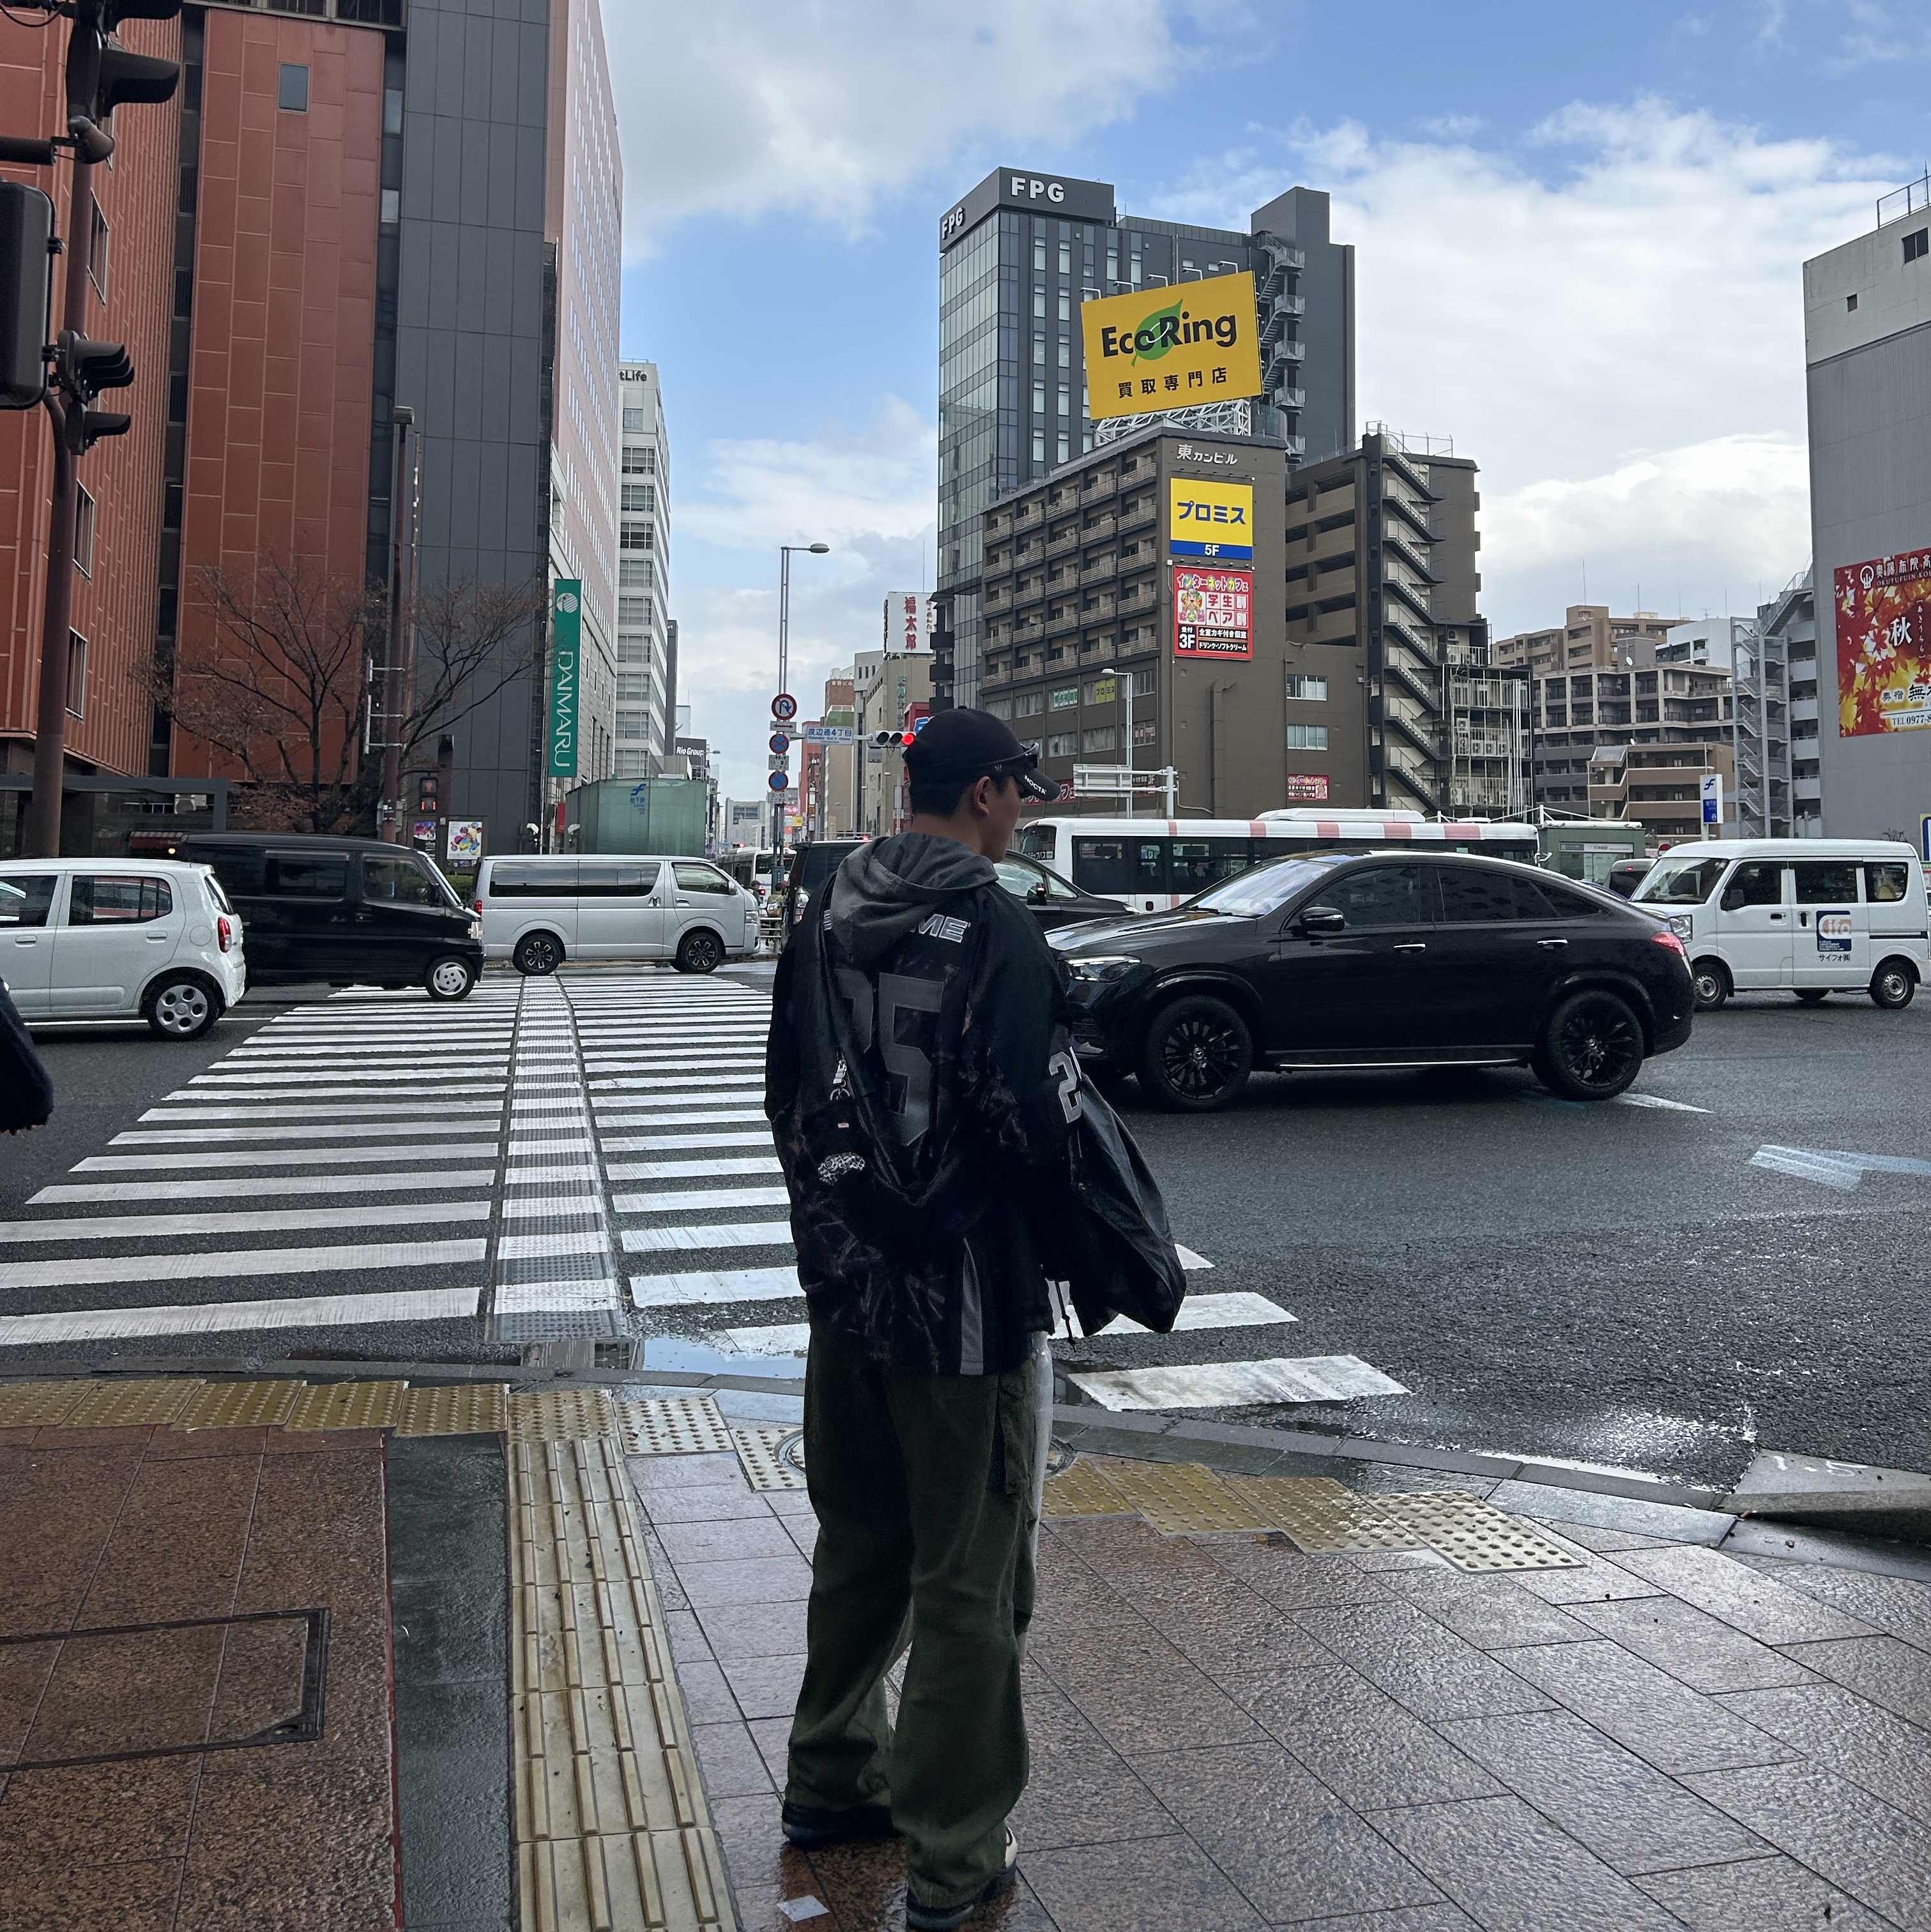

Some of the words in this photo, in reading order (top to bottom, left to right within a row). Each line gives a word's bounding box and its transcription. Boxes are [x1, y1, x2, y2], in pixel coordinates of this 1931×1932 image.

[1011, 176, 1065, 203] FPG
[941, 206, 964, 240] FPG
[1101, 311, 1237, 358] EcoRing
[1118, 367, 1228, 399] 買取専門店
[1177, 444, 1238, 465] 東カンビル
[1177, 500, 1246, 525] プロミス
[1204, 544, 1220, 556] 5F
[1177, 573, 1249, 592] インターネットカフェ
[1209, 594, 1233, 607] 学生
[903, 596, 917, 651] 福太郎
[1209, 611, 1233, 624] ペア
[1179, 634, 1195, 649] 3F
[1889, 616, 1912, 647] 秋
[554, 650, 574, 767] DAIMARU
[676, 746, 687, 755] Rio
[687, 747, 704, 757] Group
[1024, 774, 1046, 795] NOCTA
